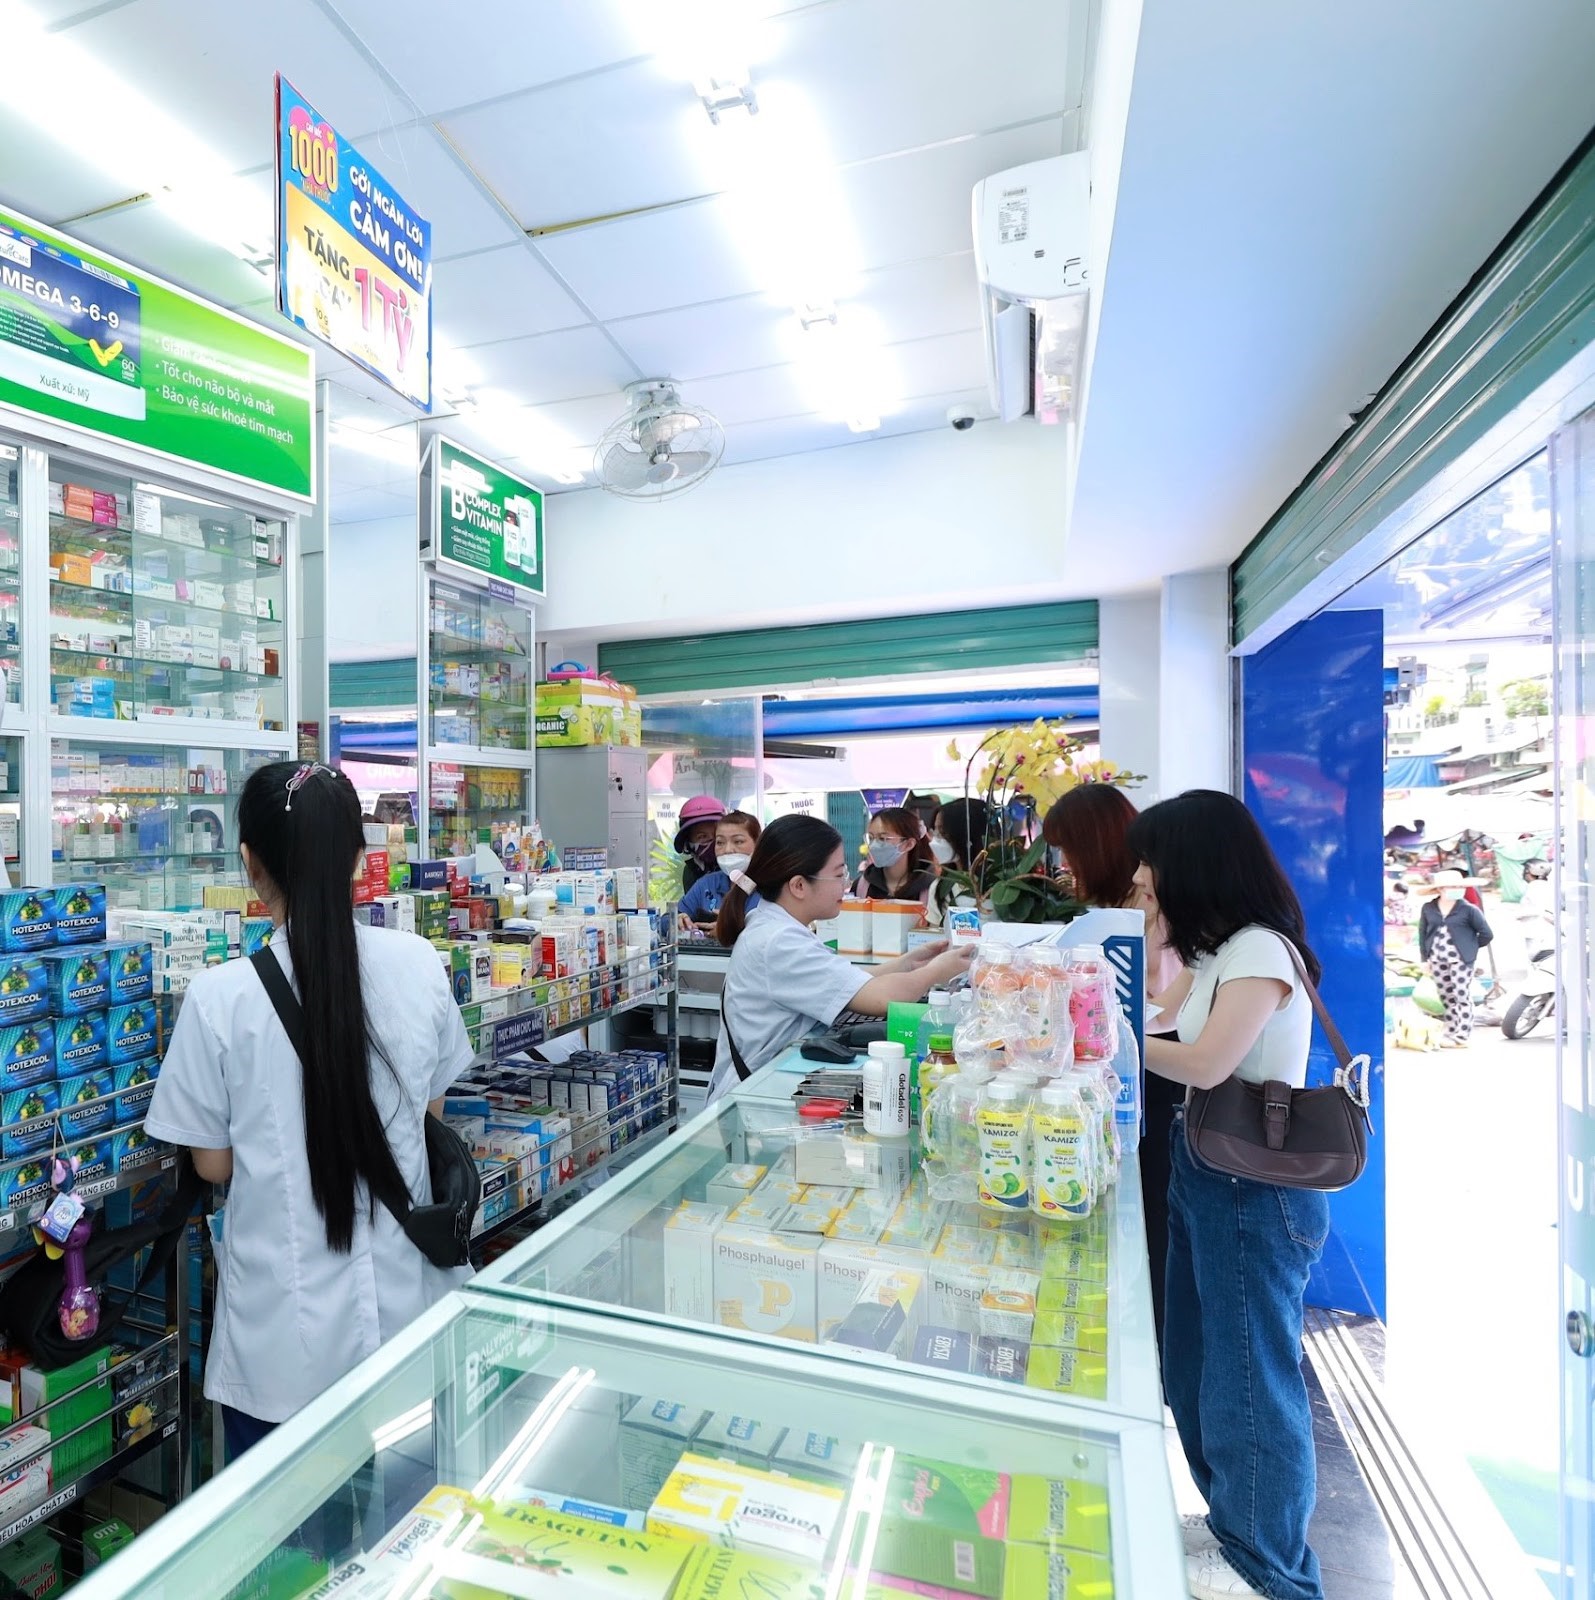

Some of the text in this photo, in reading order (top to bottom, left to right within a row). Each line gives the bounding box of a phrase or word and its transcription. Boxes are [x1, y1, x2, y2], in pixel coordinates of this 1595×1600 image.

[288, 123, 338, 193] 1000
[373, 186, 404, 230] NGÀN
[406, 218, 423, 248] LỜI
[303, 225, 350, 281] TẶNG
[350, 200, 424, 284] CẢM ƠN!
[0, 267, 64, 307] MEGA
[70, 295, 120, 329] 3-6-9
[121, 359, 135, 372] 60
[40, 374, 91, 402] Xuất xứ: Mỹ
[162, 360, 276, 417] Tốt cho não bộ và mắt
[162, 385, 294, 445] Bảo vệ sức khoẻ tim mạch
[451, 483, 466, 521] B
[465, 492, 502, 519] COMPLEX
[465, 511, 503, 537] VITAMIN
[790, 798, 815, 810] THUỐC
[12, 922, 53, 935] HOTEXCOL
[56, 916, 101, 928] HOTEXCOL
[69, 984, 105, 999] HOTEXCOL
[116, 975, 149, 988] HOTEXCOL
[63, 1043, 102, 1060] HOTEXCOL
[115, 1032, 153, 1047] HOTEXCOL
[6, 1054, 50, 1073] HOTEXCOL
[68, 1103, 108, 1121] HOTEXCOL
[10, 1118, 55, 1138] HOTEXCOL
[119, 1146, 157, 1165] HOTEXCOL
[73, 1163, 107, 1181] OTEXCOL
[8, 1181, 52, 1202] HOTEXCOL
[77, 1179, 115, 1198] HÀNG ECO
[719, 1245, 805, 1270] Phosphalugel
[759, 1279, 792, 1317] P
[933, 1335, 952, 1361] EBYSTA
[996, 1346, 1014, 1374] EBYSTA
[1055, 1351, 1077, 1387] Yumangel
[40, 1497, 62, 1517] CHẤT
[63, 1487, 75, 1500] XƠ
[1043, 1478, 1069, 1537] Yumangel
[744, 1506, 822, 1536] Varogel
[390, 1518, 433, 1556] Varogel
